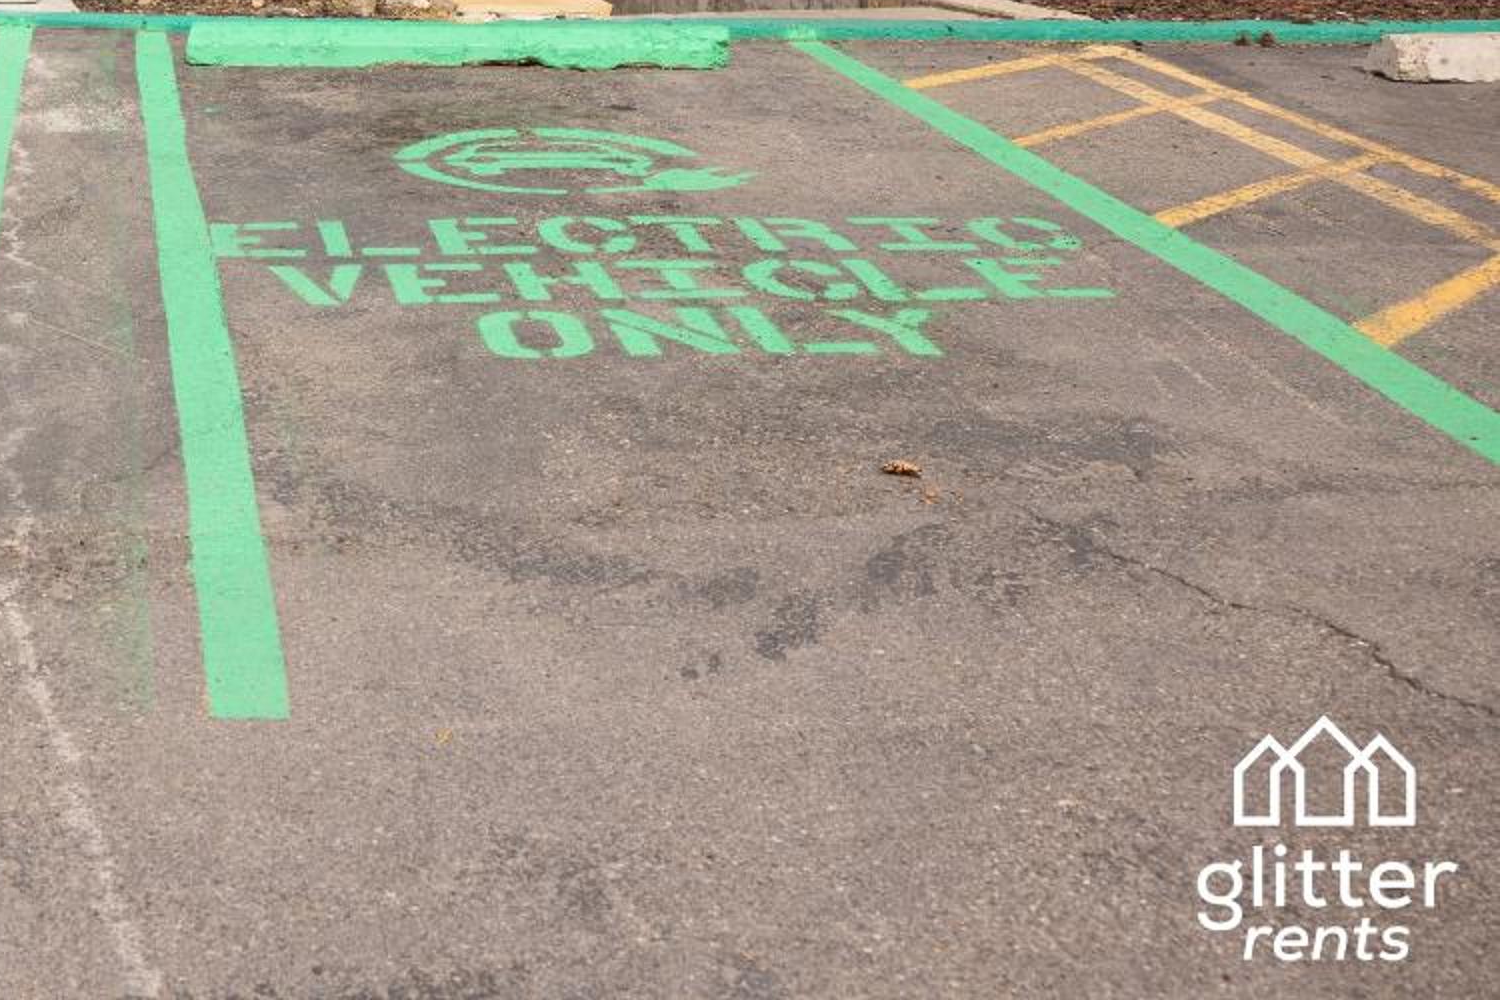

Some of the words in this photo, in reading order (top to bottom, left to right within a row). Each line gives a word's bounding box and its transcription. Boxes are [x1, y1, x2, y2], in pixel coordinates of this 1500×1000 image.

[212, 214, 1084, 259] ELECTRIC
[267, 258, 1117, 306] VEHICLE
[474, 307, 946, 359] ONLY
